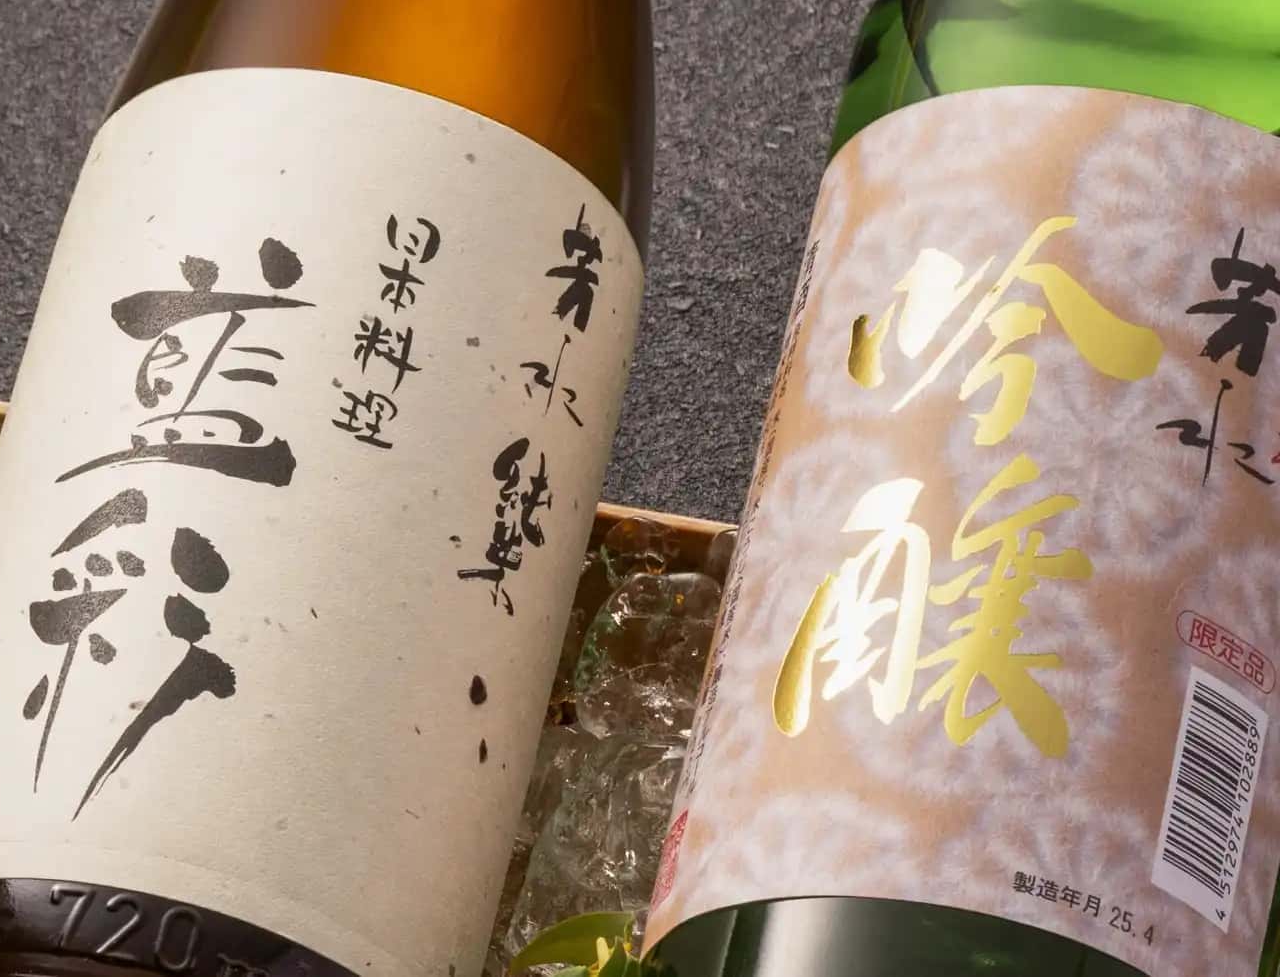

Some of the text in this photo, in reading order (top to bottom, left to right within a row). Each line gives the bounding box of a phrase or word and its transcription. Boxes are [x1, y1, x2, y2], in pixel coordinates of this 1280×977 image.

[332, 214, 441, 450] 日本料理
[1190, 618, 1265, 686] 限定品
[1238, 726, 1261, 802] 102889
[1012, 871, 1101, 918] 製造年月
